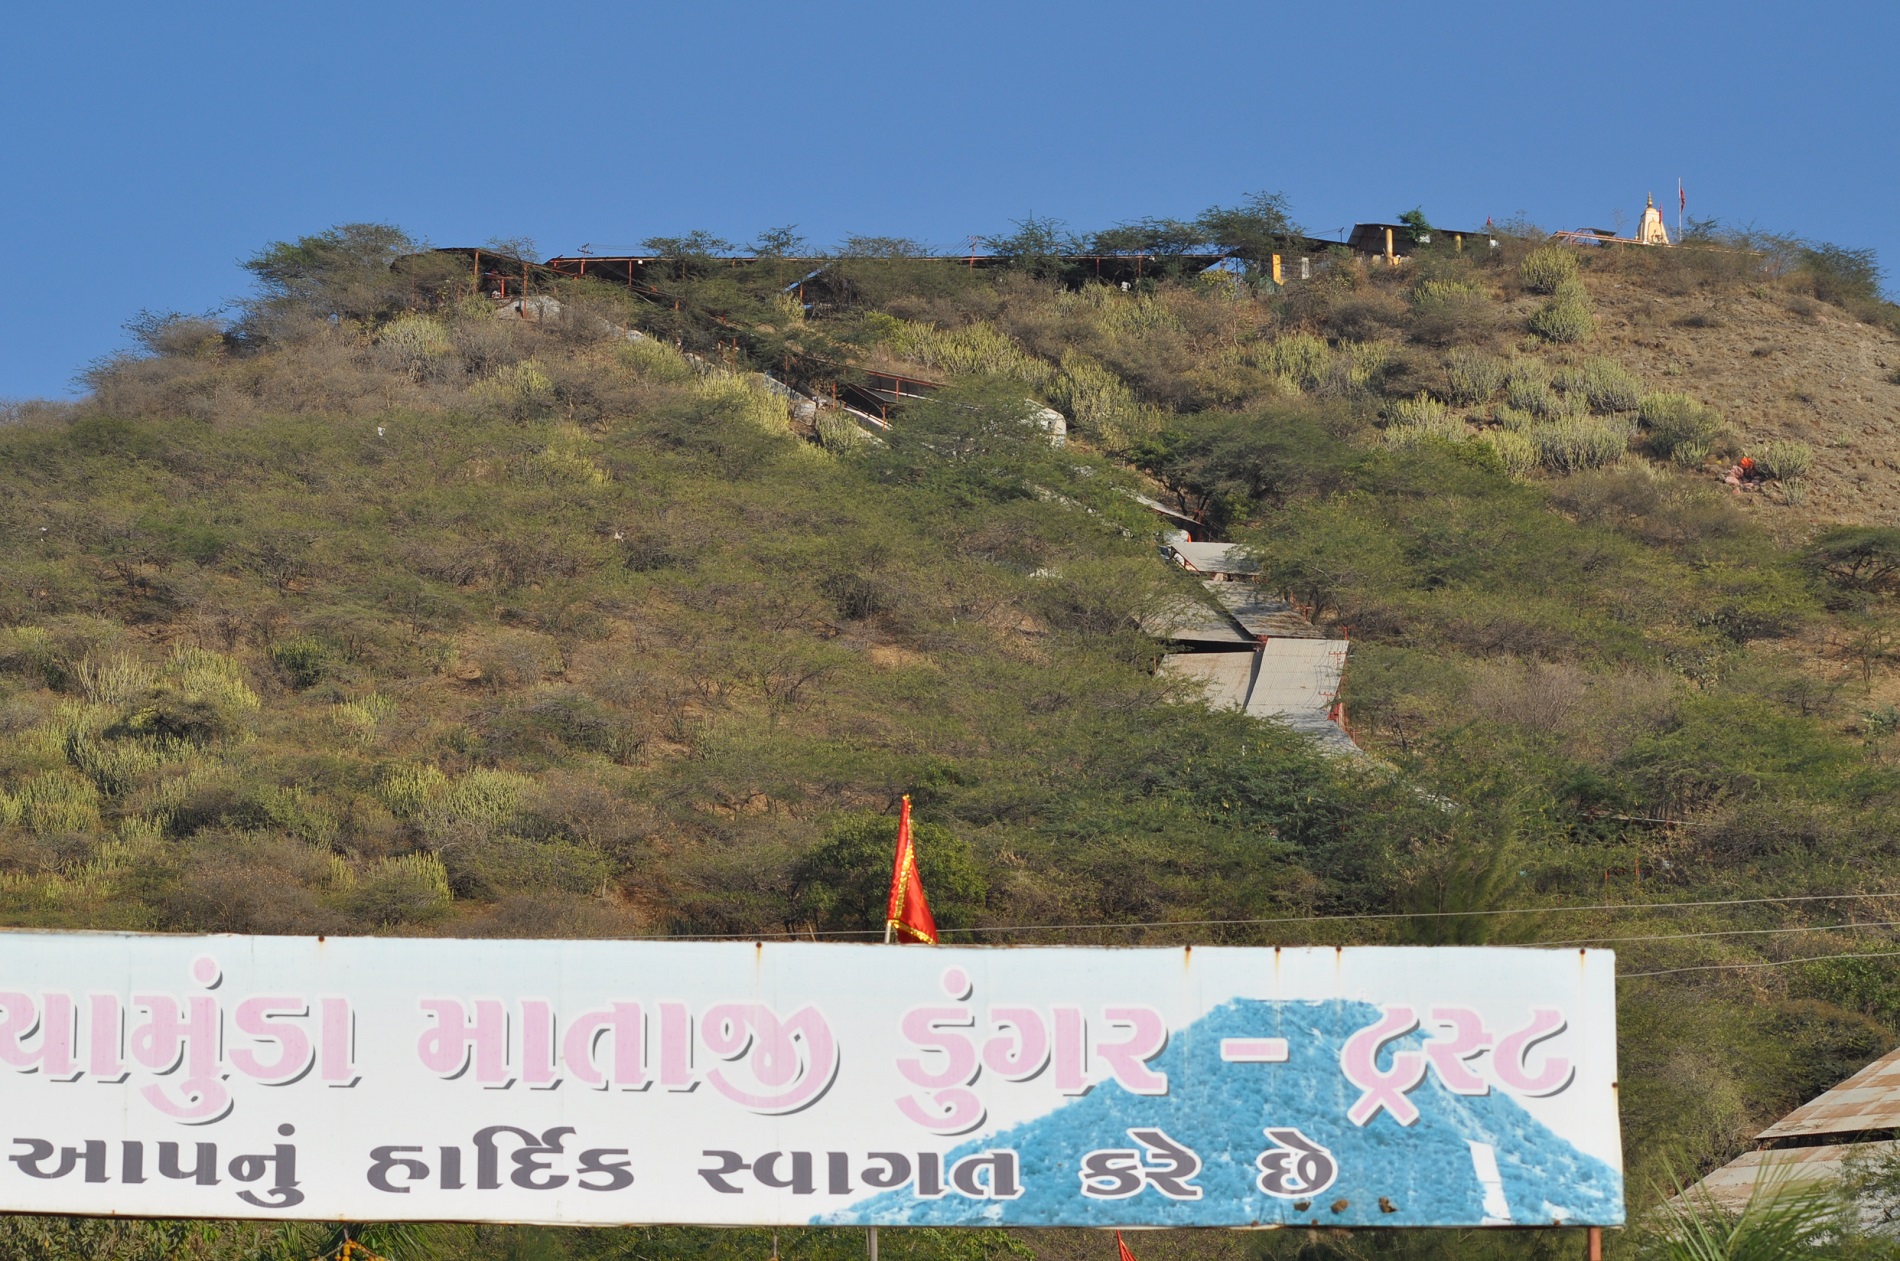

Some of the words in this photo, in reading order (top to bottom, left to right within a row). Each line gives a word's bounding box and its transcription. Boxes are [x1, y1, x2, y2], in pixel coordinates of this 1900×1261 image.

[418, 998, 840, 1116] માતાજી
[895, 967, 1168, 1135] ડુંગર
[1344, 1006, 1575, 1126] ટ્રસ્ટ
[8, 1123, 305, 1208] આપનું
[366, 1125, 634, 1194] હાર્દિક
[698, 1149, 1022, 1197] સ્વાગત
[1082, 1129, 1202, 1198] કરે
[1258, 1128, 1336, 1196] છે
